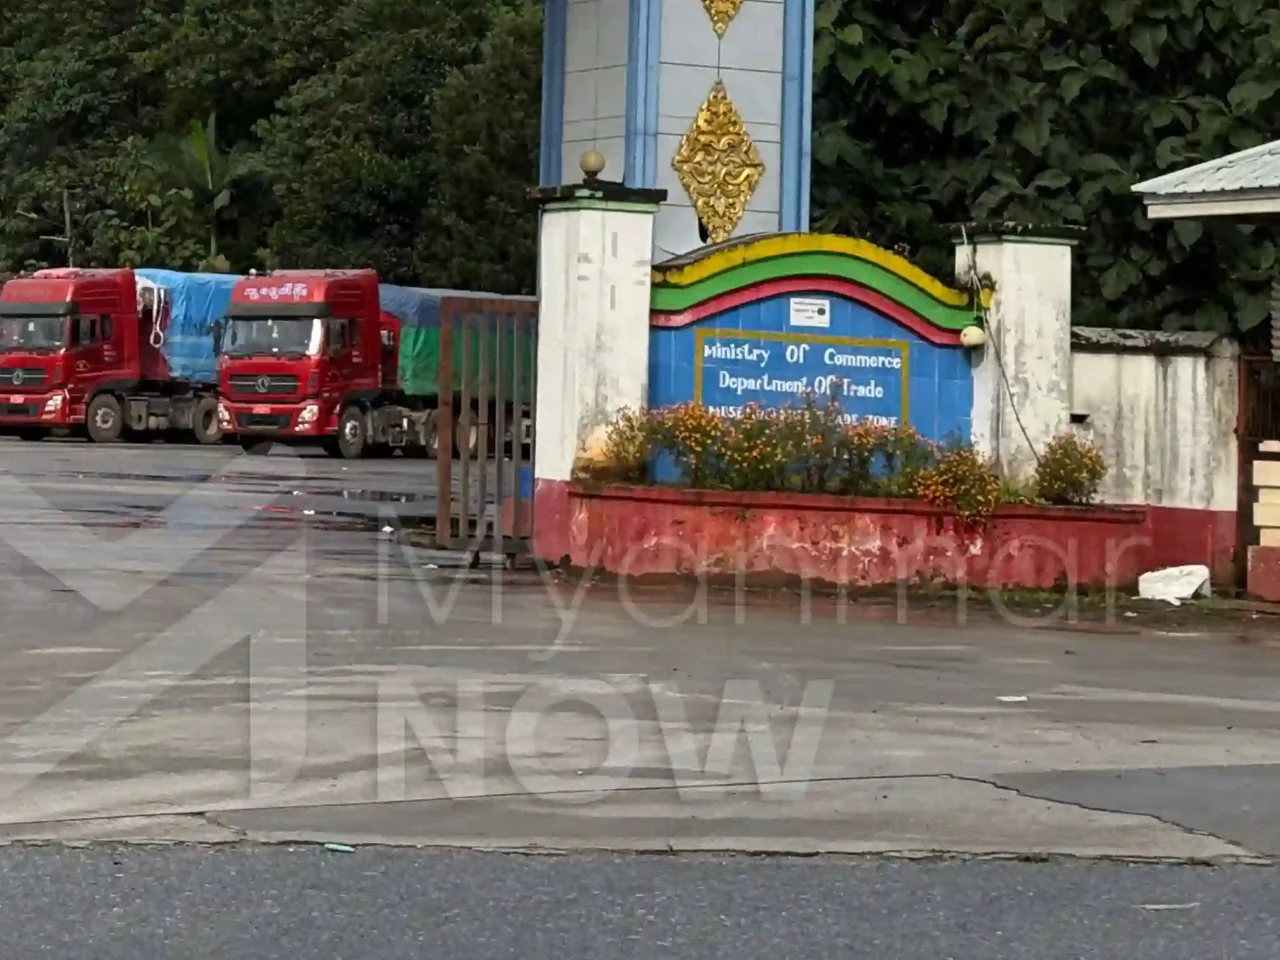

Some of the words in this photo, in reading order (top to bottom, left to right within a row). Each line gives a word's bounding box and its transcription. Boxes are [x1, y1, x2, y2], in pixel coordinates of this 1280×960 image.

[704, 343, 771, 368] Ministry
[785, 343, 810, 364] Of
[824, 347, 902, 369] Commerce
[719, 371, 808, 395] Department
[843, 377, 884, 398] Trade
[816, 410, 860, 427] TADE
